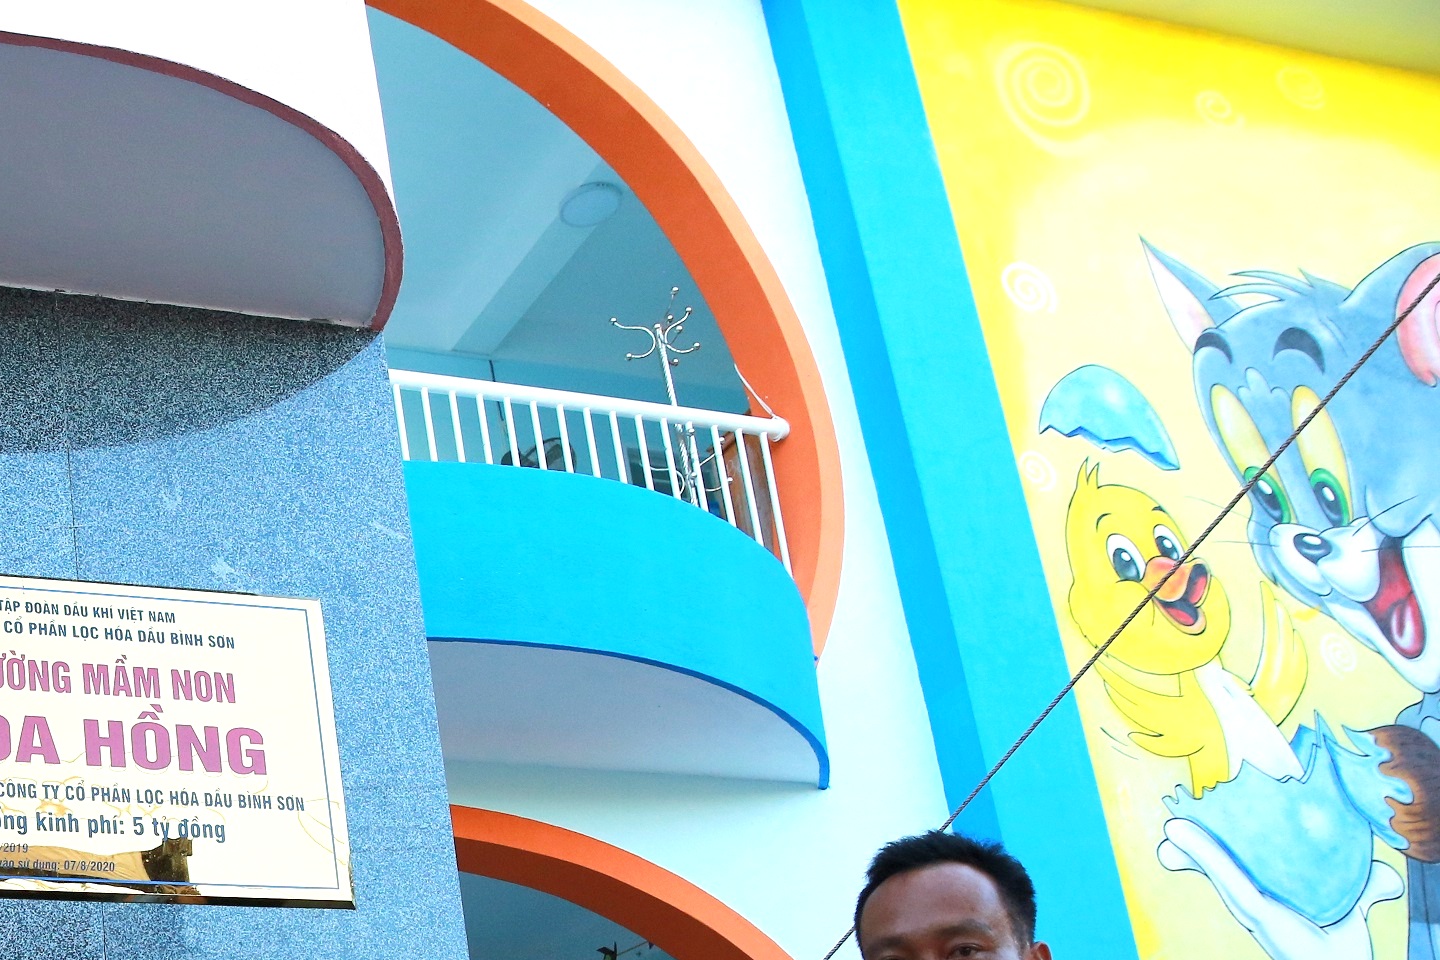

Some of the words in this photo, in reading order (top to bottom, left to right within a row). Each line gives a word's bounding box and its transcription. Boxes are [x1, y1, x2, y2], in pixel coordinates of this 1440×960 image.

[25, 600, 59, 615] ĐOÀN
[64, 601, 88, 617] DẦU
[93, 605, 113, 619] KHÍ
[118, 607, 143, 623] VIỆT
[149, 611, 176, 624] NAM
[4, 616, 24, 634] CỔ
[29, 619, 67, 637] PHẦN
[72, 625, 99, 641] LỌC
[104, 626, 133, 642] HÓA
[138, 627, 165, 644] DẦU
[170, 630, 203, 647] BÌNH
[208, 635, 235, 649] SƠN
[82, 655, 161, 699] MẦM
[171, 669, 237, 703] NON
[83, 704, 267, 776] HỒNG
[42, 784, 59, 800] TY
[65, 780, 86, 801] CỔ
[91, 783, 131, 803] PHẦN
[136, 789, 164, 807] LỌC
[169, 788, 199, 807] HÓA
[204, 788, 233, 808] DẦU
[238, 792, 272, 810] BÌNH
[277, 796, 305, 812] SƠN
[36, 812, 80, 833] kinh
[87, 815, 125, 838] phí:
[133, 816, 144, 836] 5
[152, 816, 170, 842] tỷ
[178, 816, 226, 844] đồng
[64, 860, 115, 872] 07/8/2020
